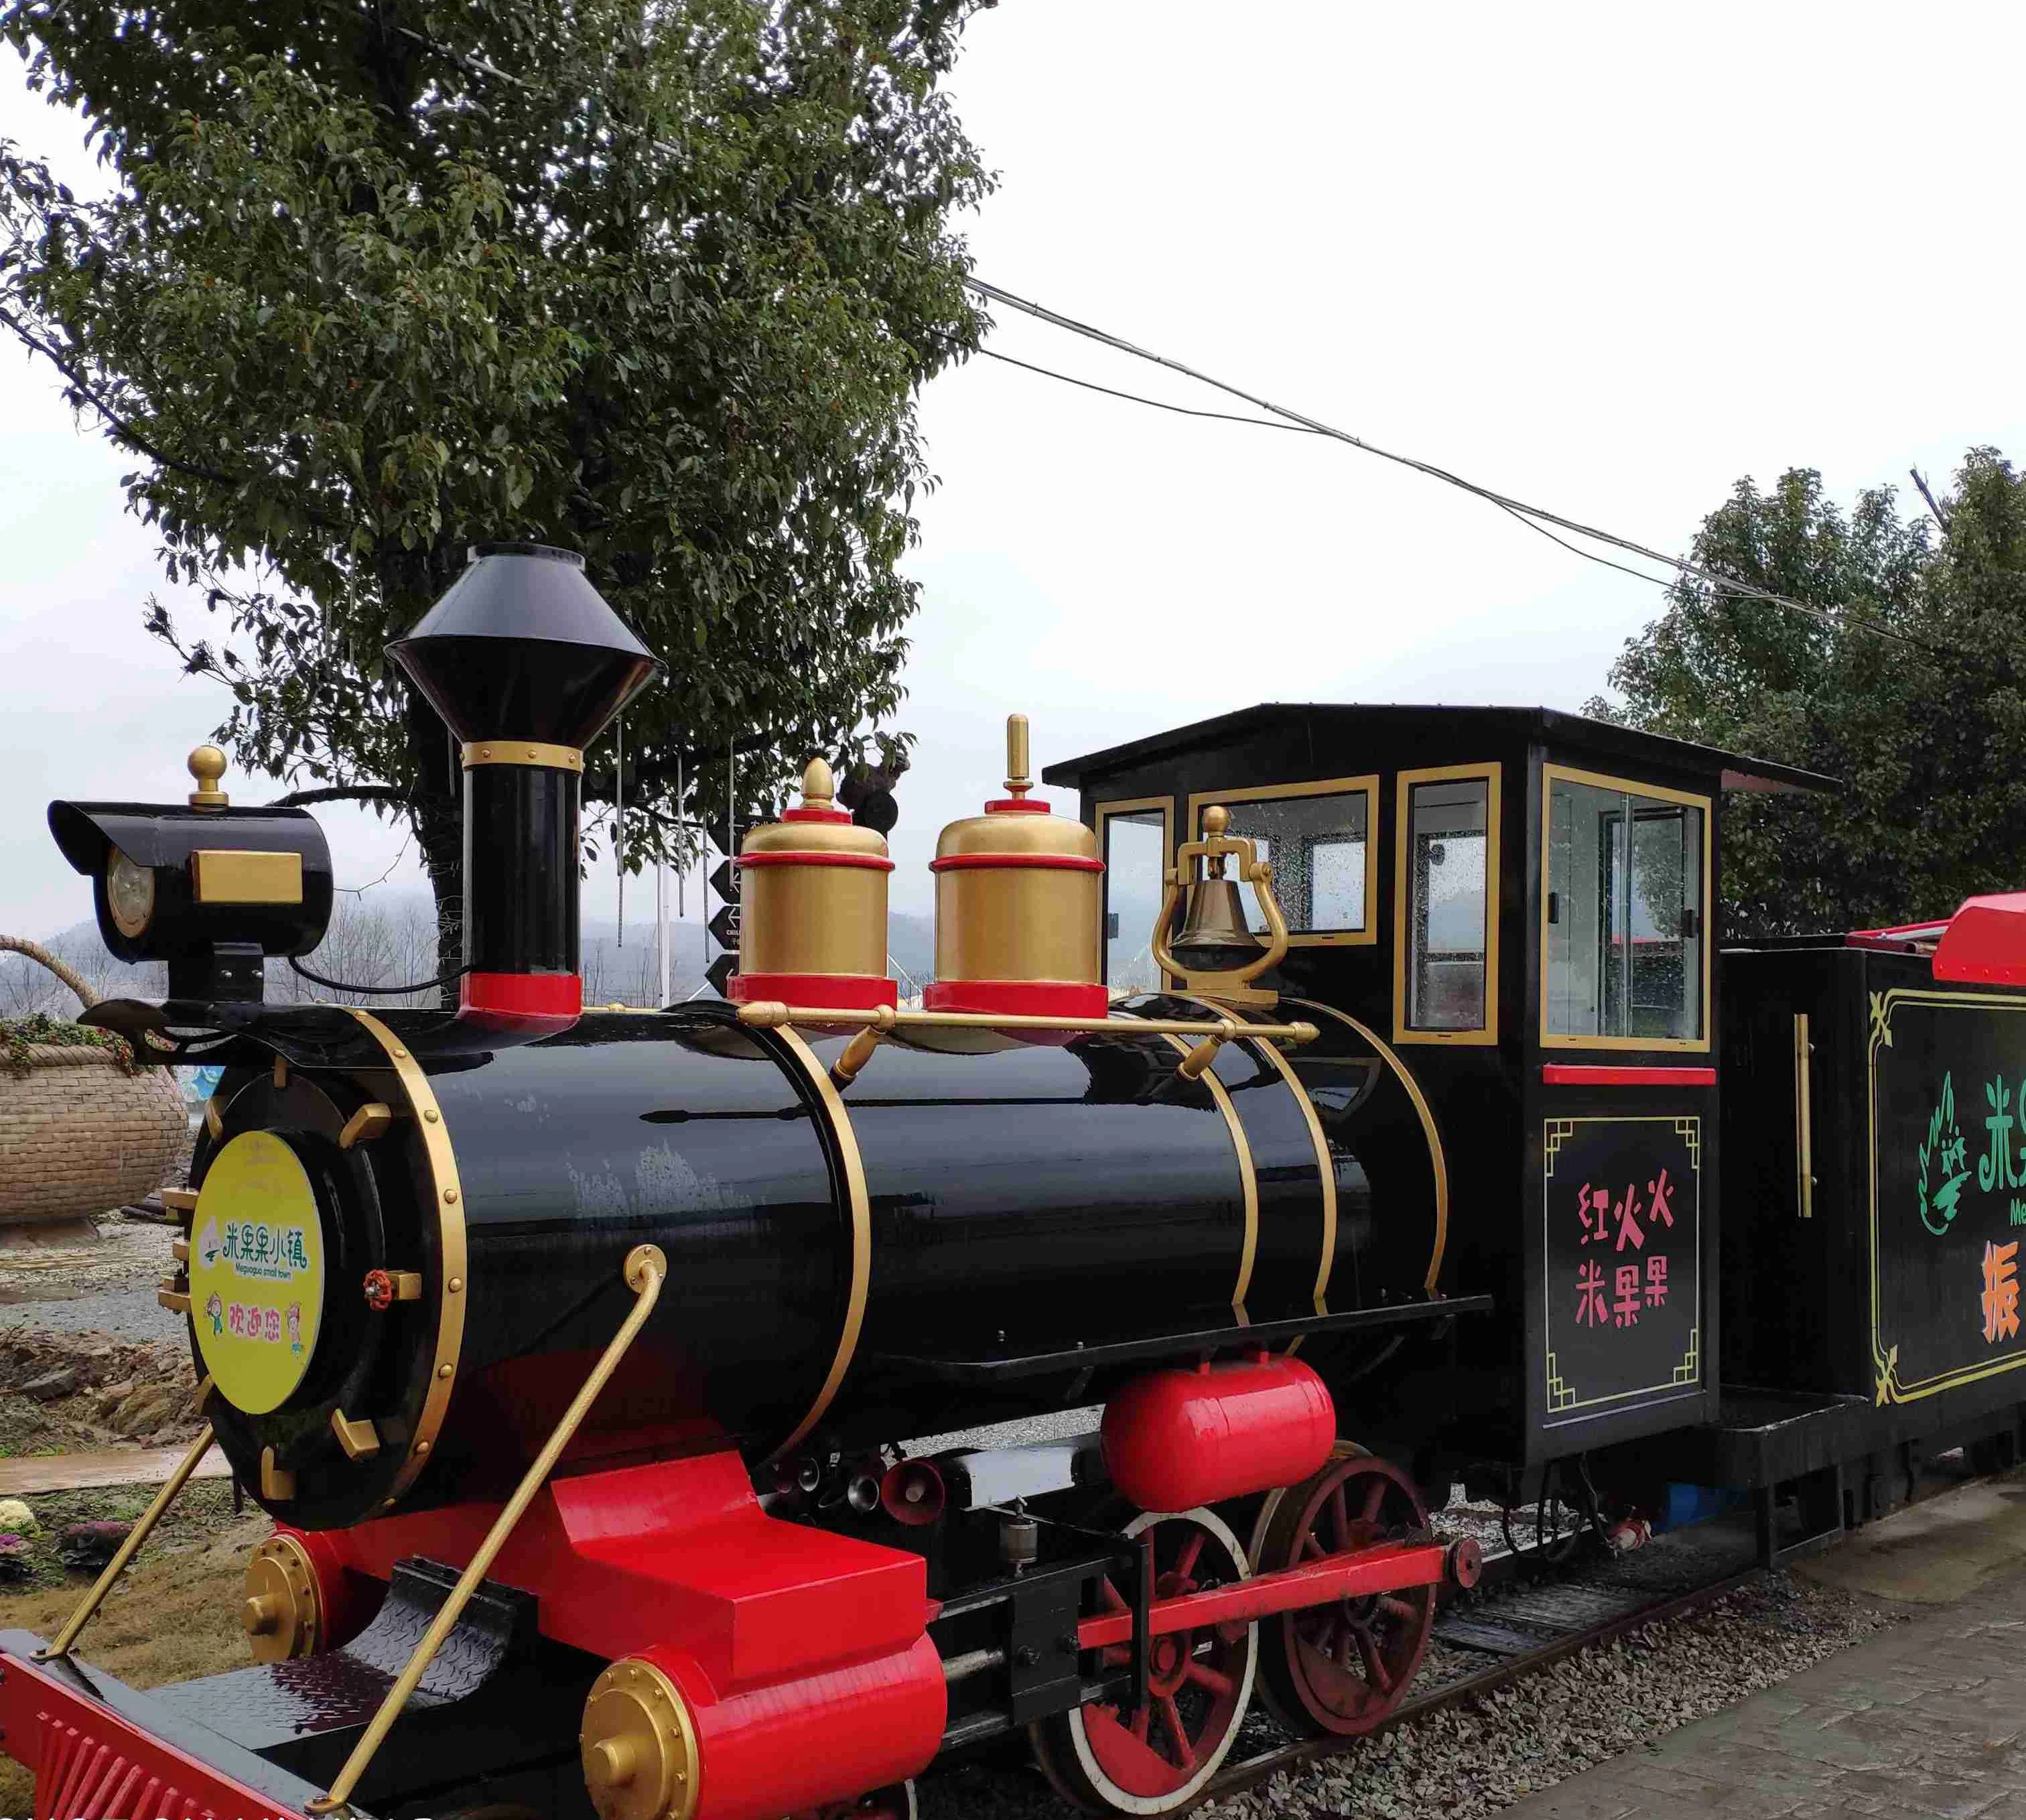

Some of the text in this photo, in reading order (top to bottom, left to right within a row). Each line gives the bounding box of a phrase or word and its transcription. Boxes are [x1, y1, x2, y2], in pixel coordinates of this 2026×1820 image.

[1978, 1074, 2026, 1191] 米
[223, 1222, 307, 1269] 米果果小镇
[1578, 1168, 1674, 1252] 红火火
[230, 1303, 279, 1341] 欢迎您
[1576, 1255, 1668, 1329] 米果果
